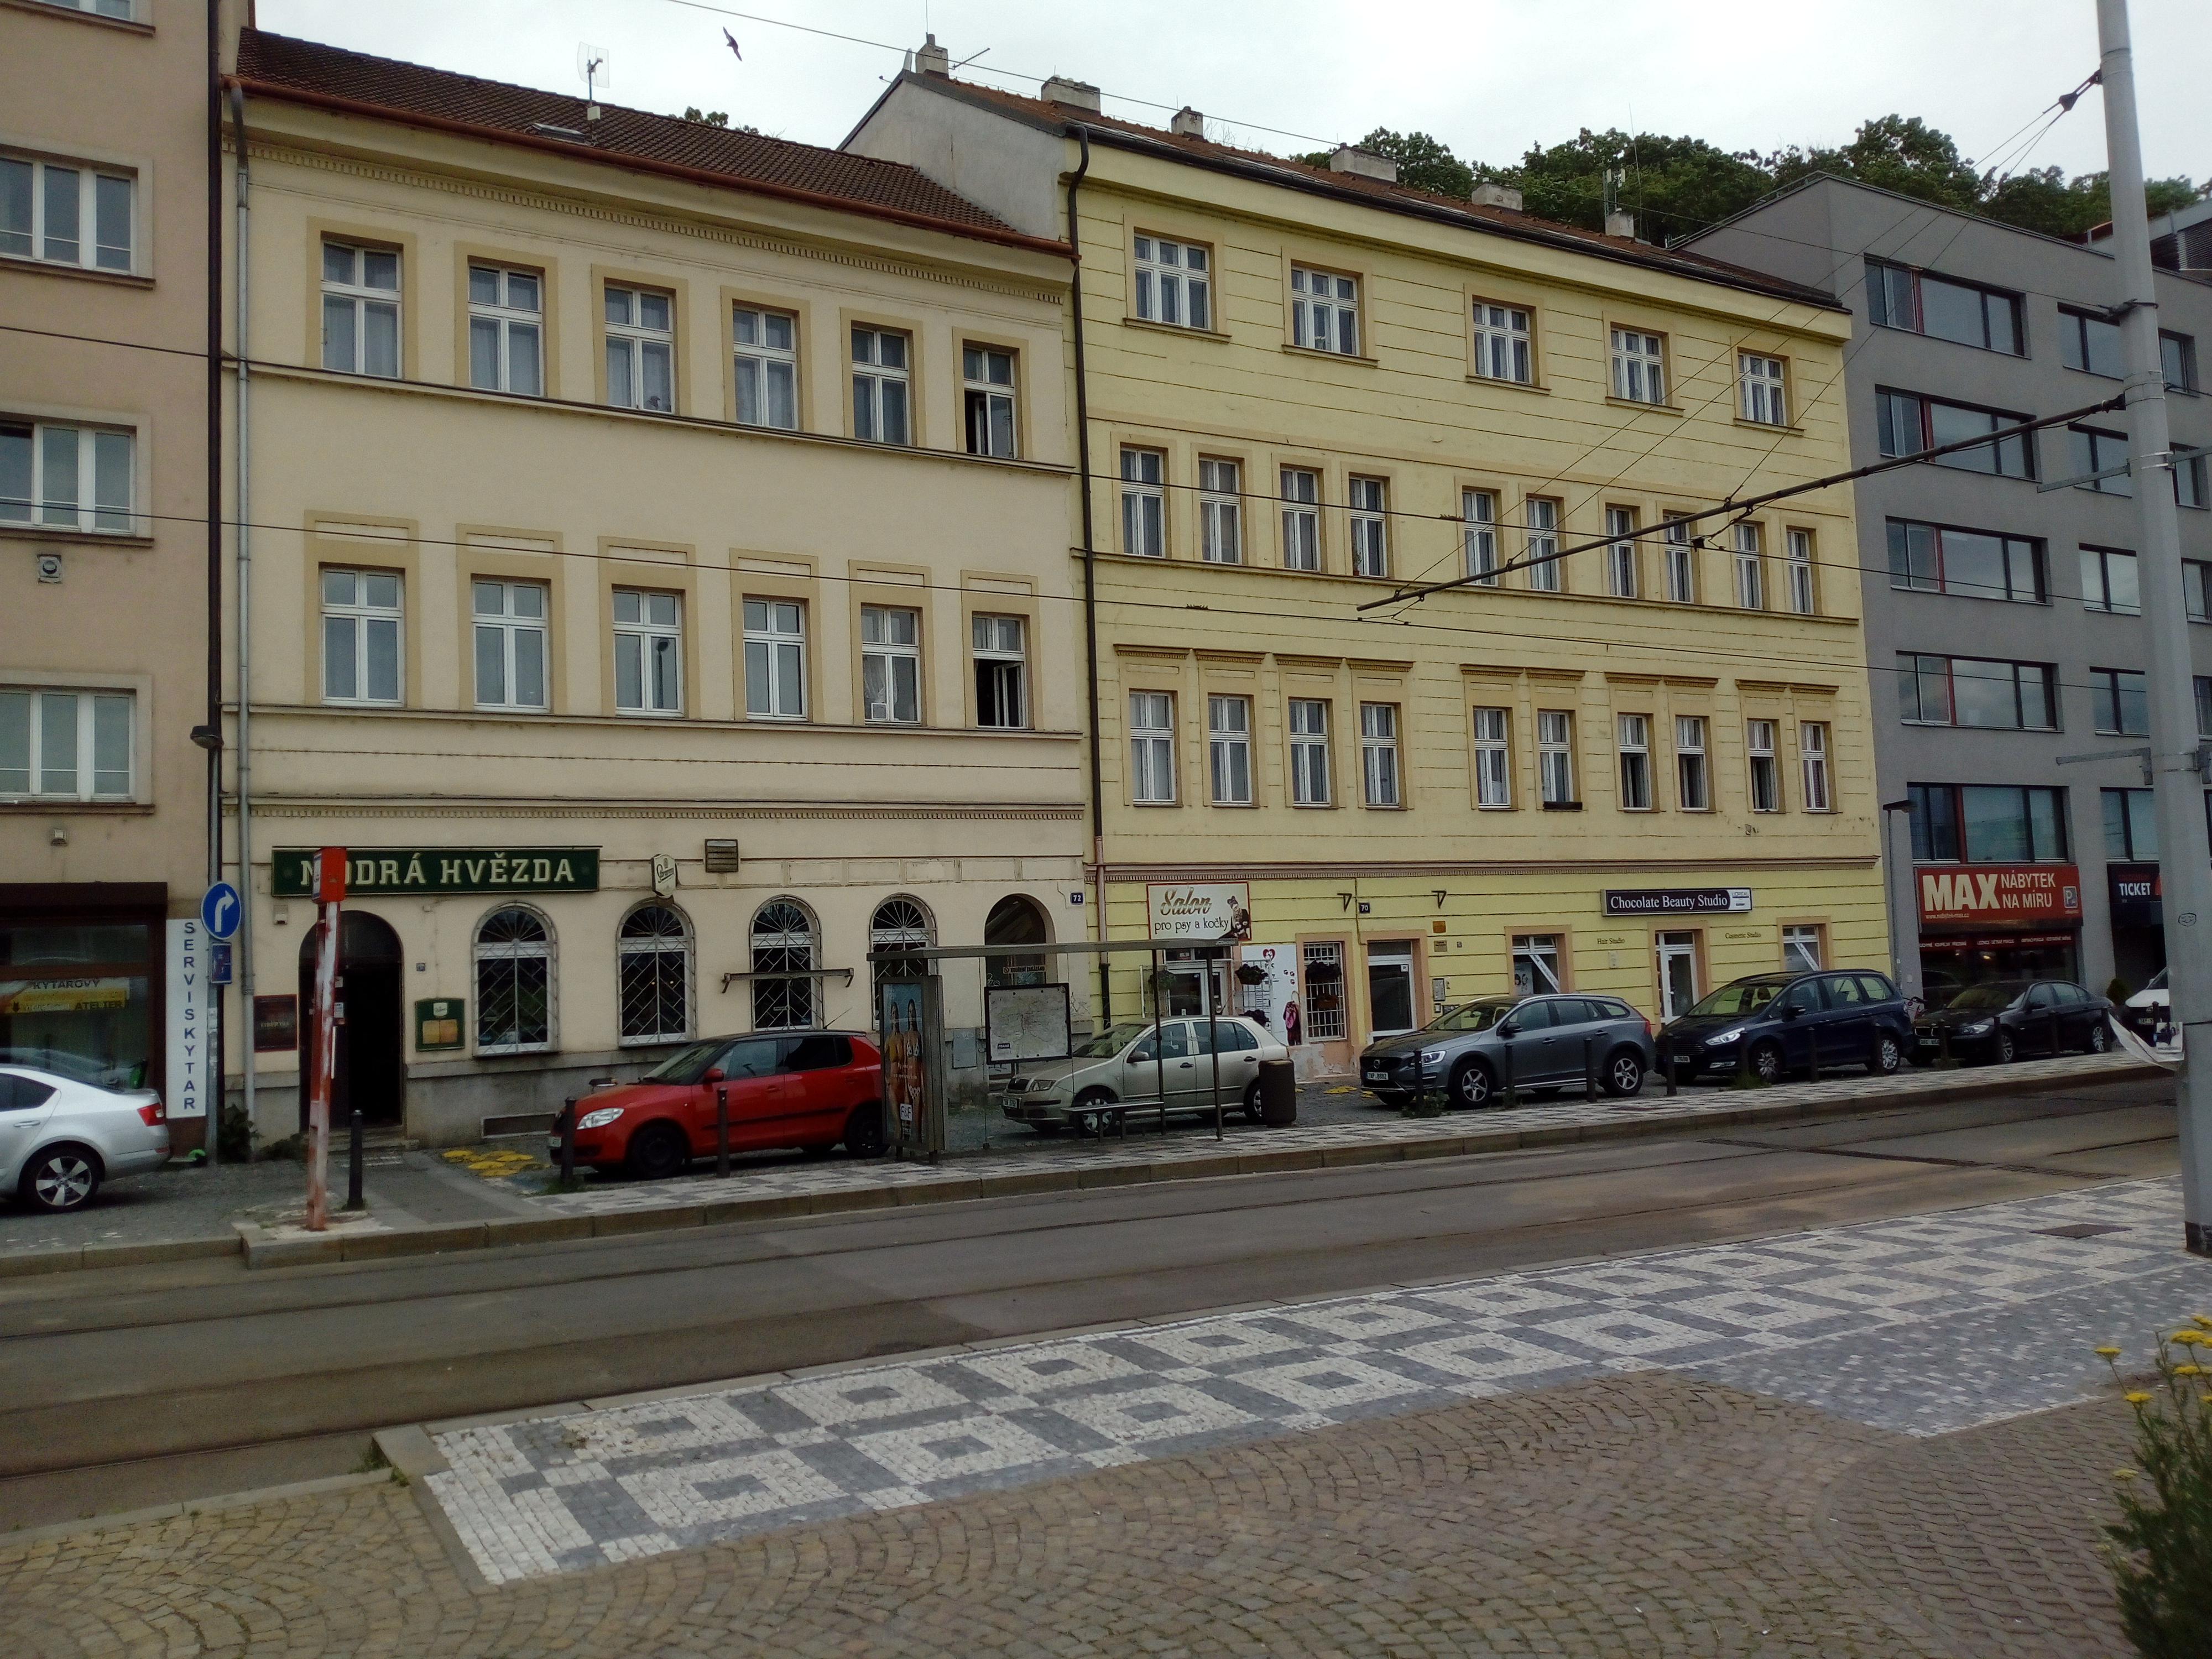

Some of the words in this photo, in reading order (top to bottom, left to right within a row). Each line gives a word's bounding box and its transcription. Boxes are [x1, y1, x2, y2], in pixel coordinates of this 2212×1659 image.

[300, 852, 427, 885] MDRÁ
[440, 852, 575, 884] HVĚZDA
[2001, 870, 2056, 889] NÁBYTEK
[2119, 882, 2151, 896] TICKET
[1161, 886, 1212, 916] Salon
[1610, 895, 1660, 909] Chocolate
[1662, 895, 1695, 910] Beauty
[1698, 894, 1728, 907] Studio
[1922, 874, 2001, 911] MAX
[2002, 893, 2020, 909] NA
[2022, 890, 2052, 909] MÍRU
[1155, 921, 1172, 935] pro
[1175, 921, 1191, 933] psy
[1203, 916, 1229, 932] kočky
